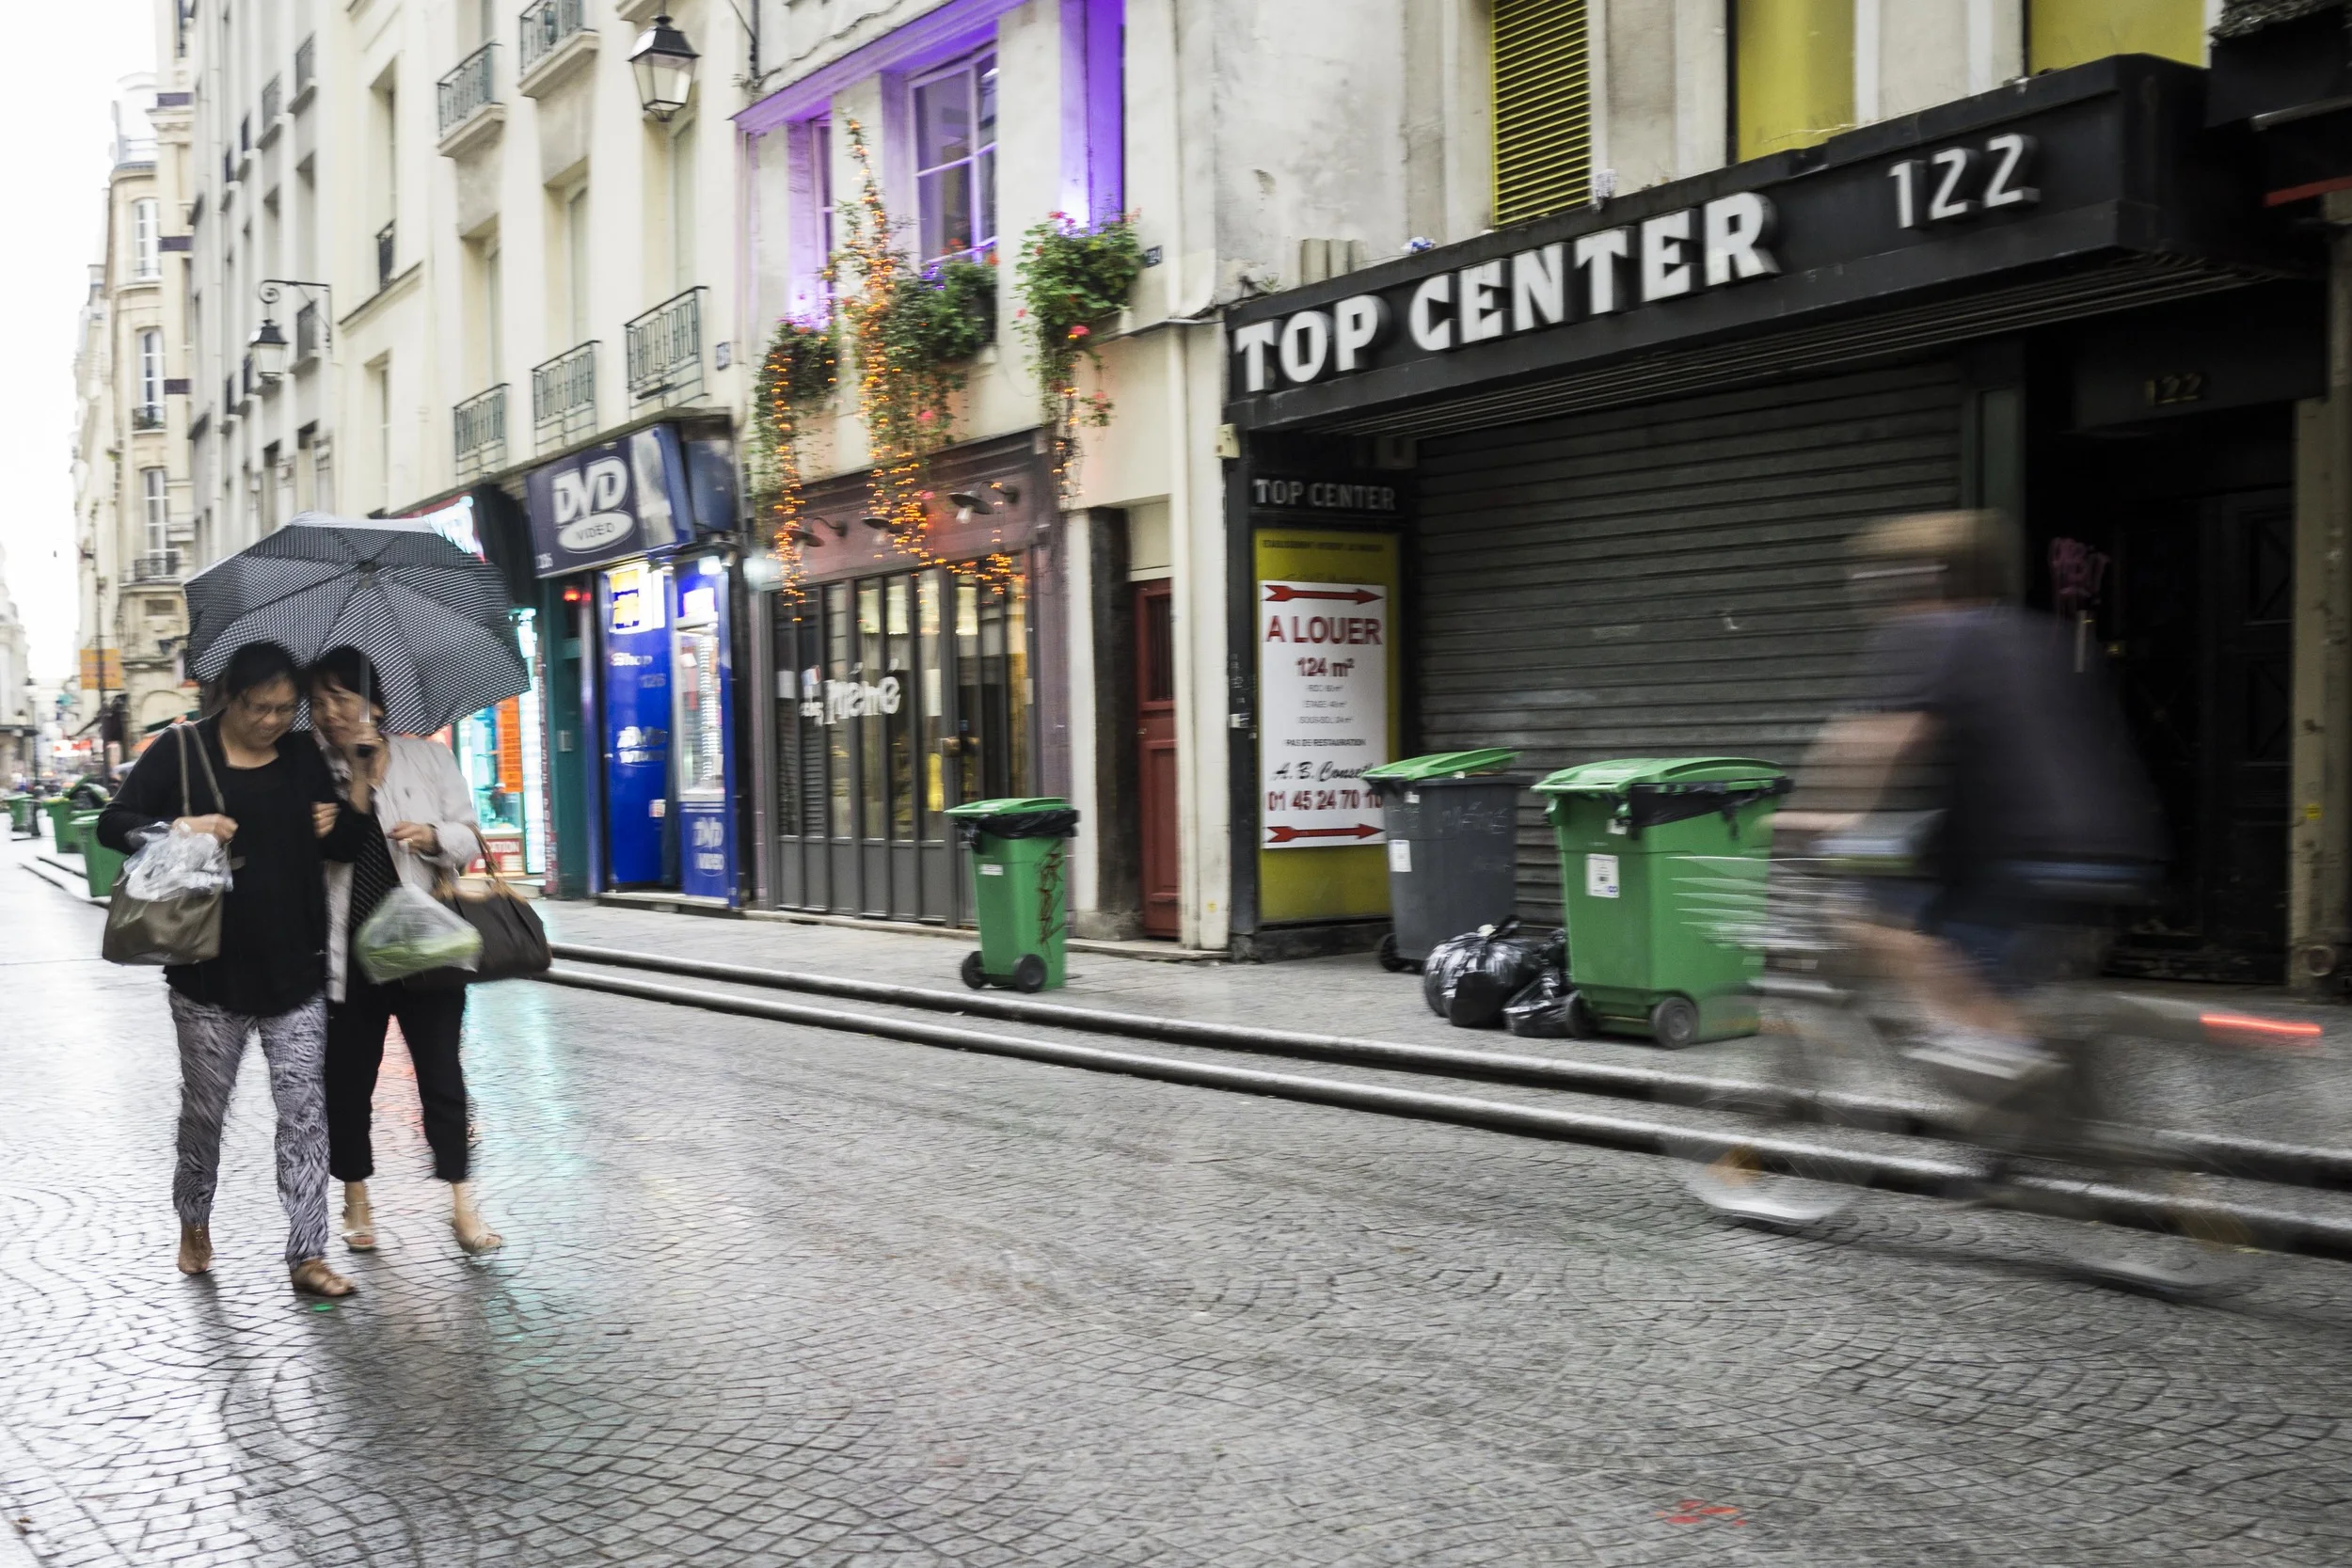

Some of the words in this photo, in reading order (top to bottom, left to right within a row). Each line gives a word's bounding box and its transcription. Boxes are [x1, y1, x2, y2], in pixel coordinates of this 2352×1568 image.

[1234, 294, 1385, 392] TOP
[1409, 191, 1778, 352] CENTER
[1888, 134, 2034, 229] 122
[550, 457, 628, 527] DVD
[1252, 479, 1304, 505] TOP
[1309, 483, 1396, 511] CENTER
[1264, 615, 1287, 642] A
[1291, 616, 1383, 645] LOUER
[1296, 657, 1327, 676] 124
[1267, 791, 1286, 811] 01
[1292, 790, 1312, 810] 45
[1316, 790, 1336, 810] 24
[1340, 789, 1360, 809] 70
